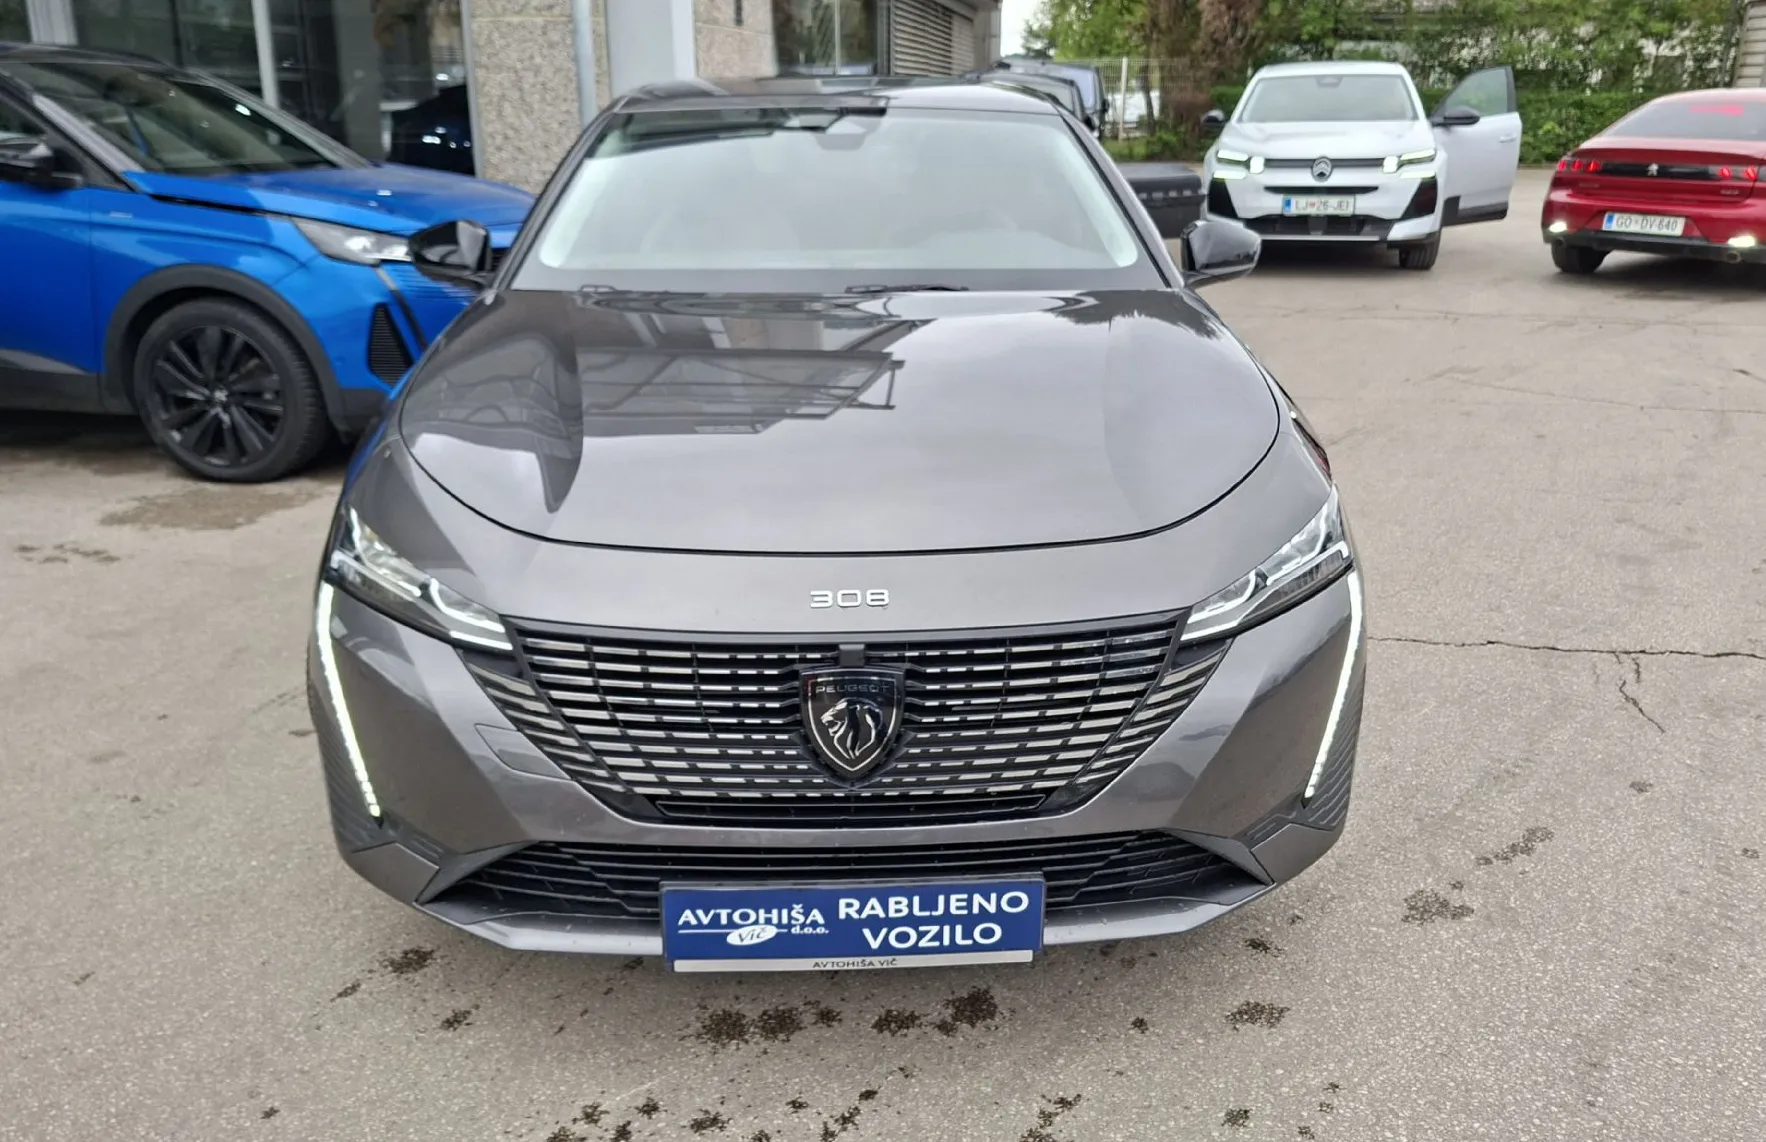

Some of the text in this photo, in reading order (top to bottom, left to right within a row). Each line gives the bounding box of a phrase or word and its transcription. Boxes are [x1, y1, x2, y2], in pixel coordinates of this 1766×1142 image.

[1615, 215, 1633, 229] GO
[810, 589, 890, 608] 308
[815, 683, 891, 694] PEUGEOT
[677, 903, 825, 926] AVTOHIŠA
[838, 891, 1029, 920] RABLJENO
[738, 924, 768, 943] Vič
[790, 925, 830, 935] d.o.o.
[861, 922, 1003, 950] VOZILO
[812, 958, 876, 969] AVTOHIŠA
